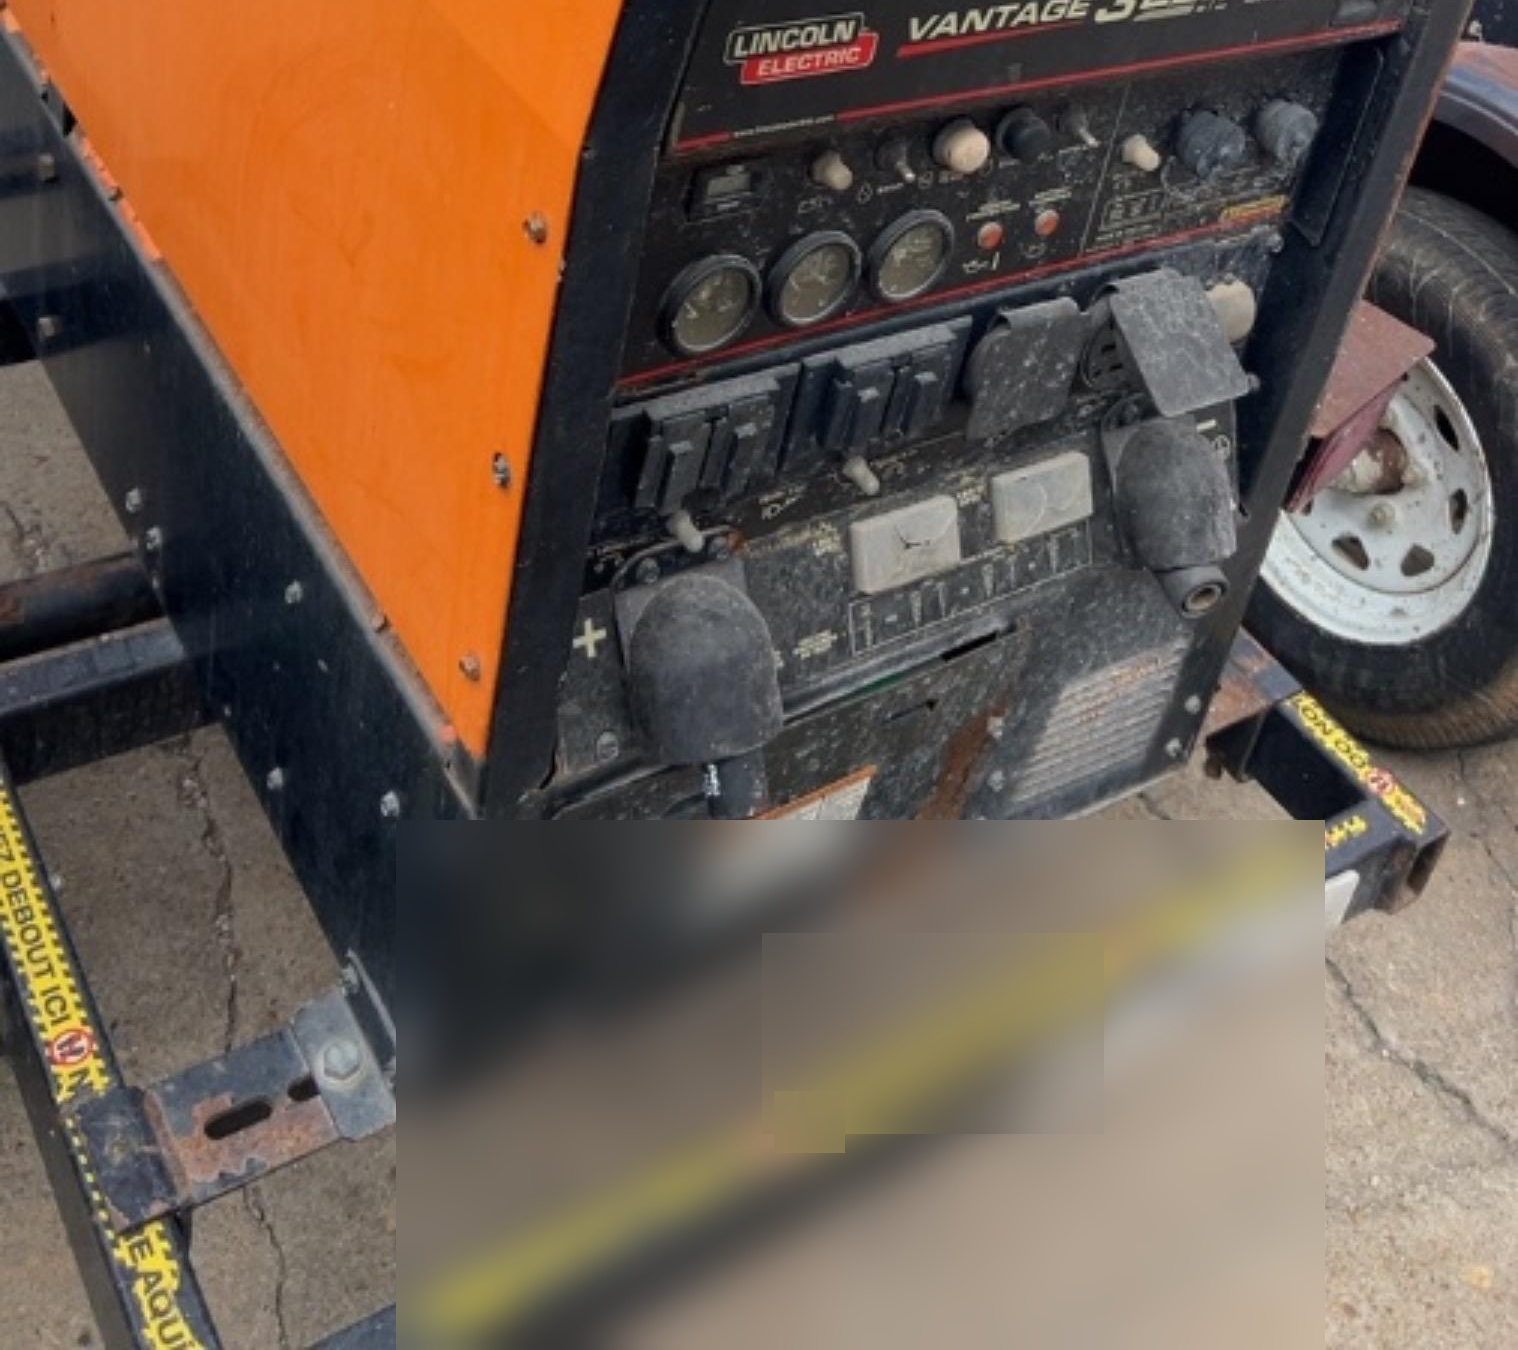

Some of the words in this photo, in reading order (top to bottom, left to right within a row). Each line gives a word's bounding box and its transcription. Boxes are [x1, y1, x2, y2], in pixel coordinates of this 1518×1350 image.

[734, 19, 857, 58] LINCOLN
[757, 47, 862, 76] ELECTRIC
[2, 869, 56, 978] DEBOUT
[42, 982, 71, 1026] ICI
